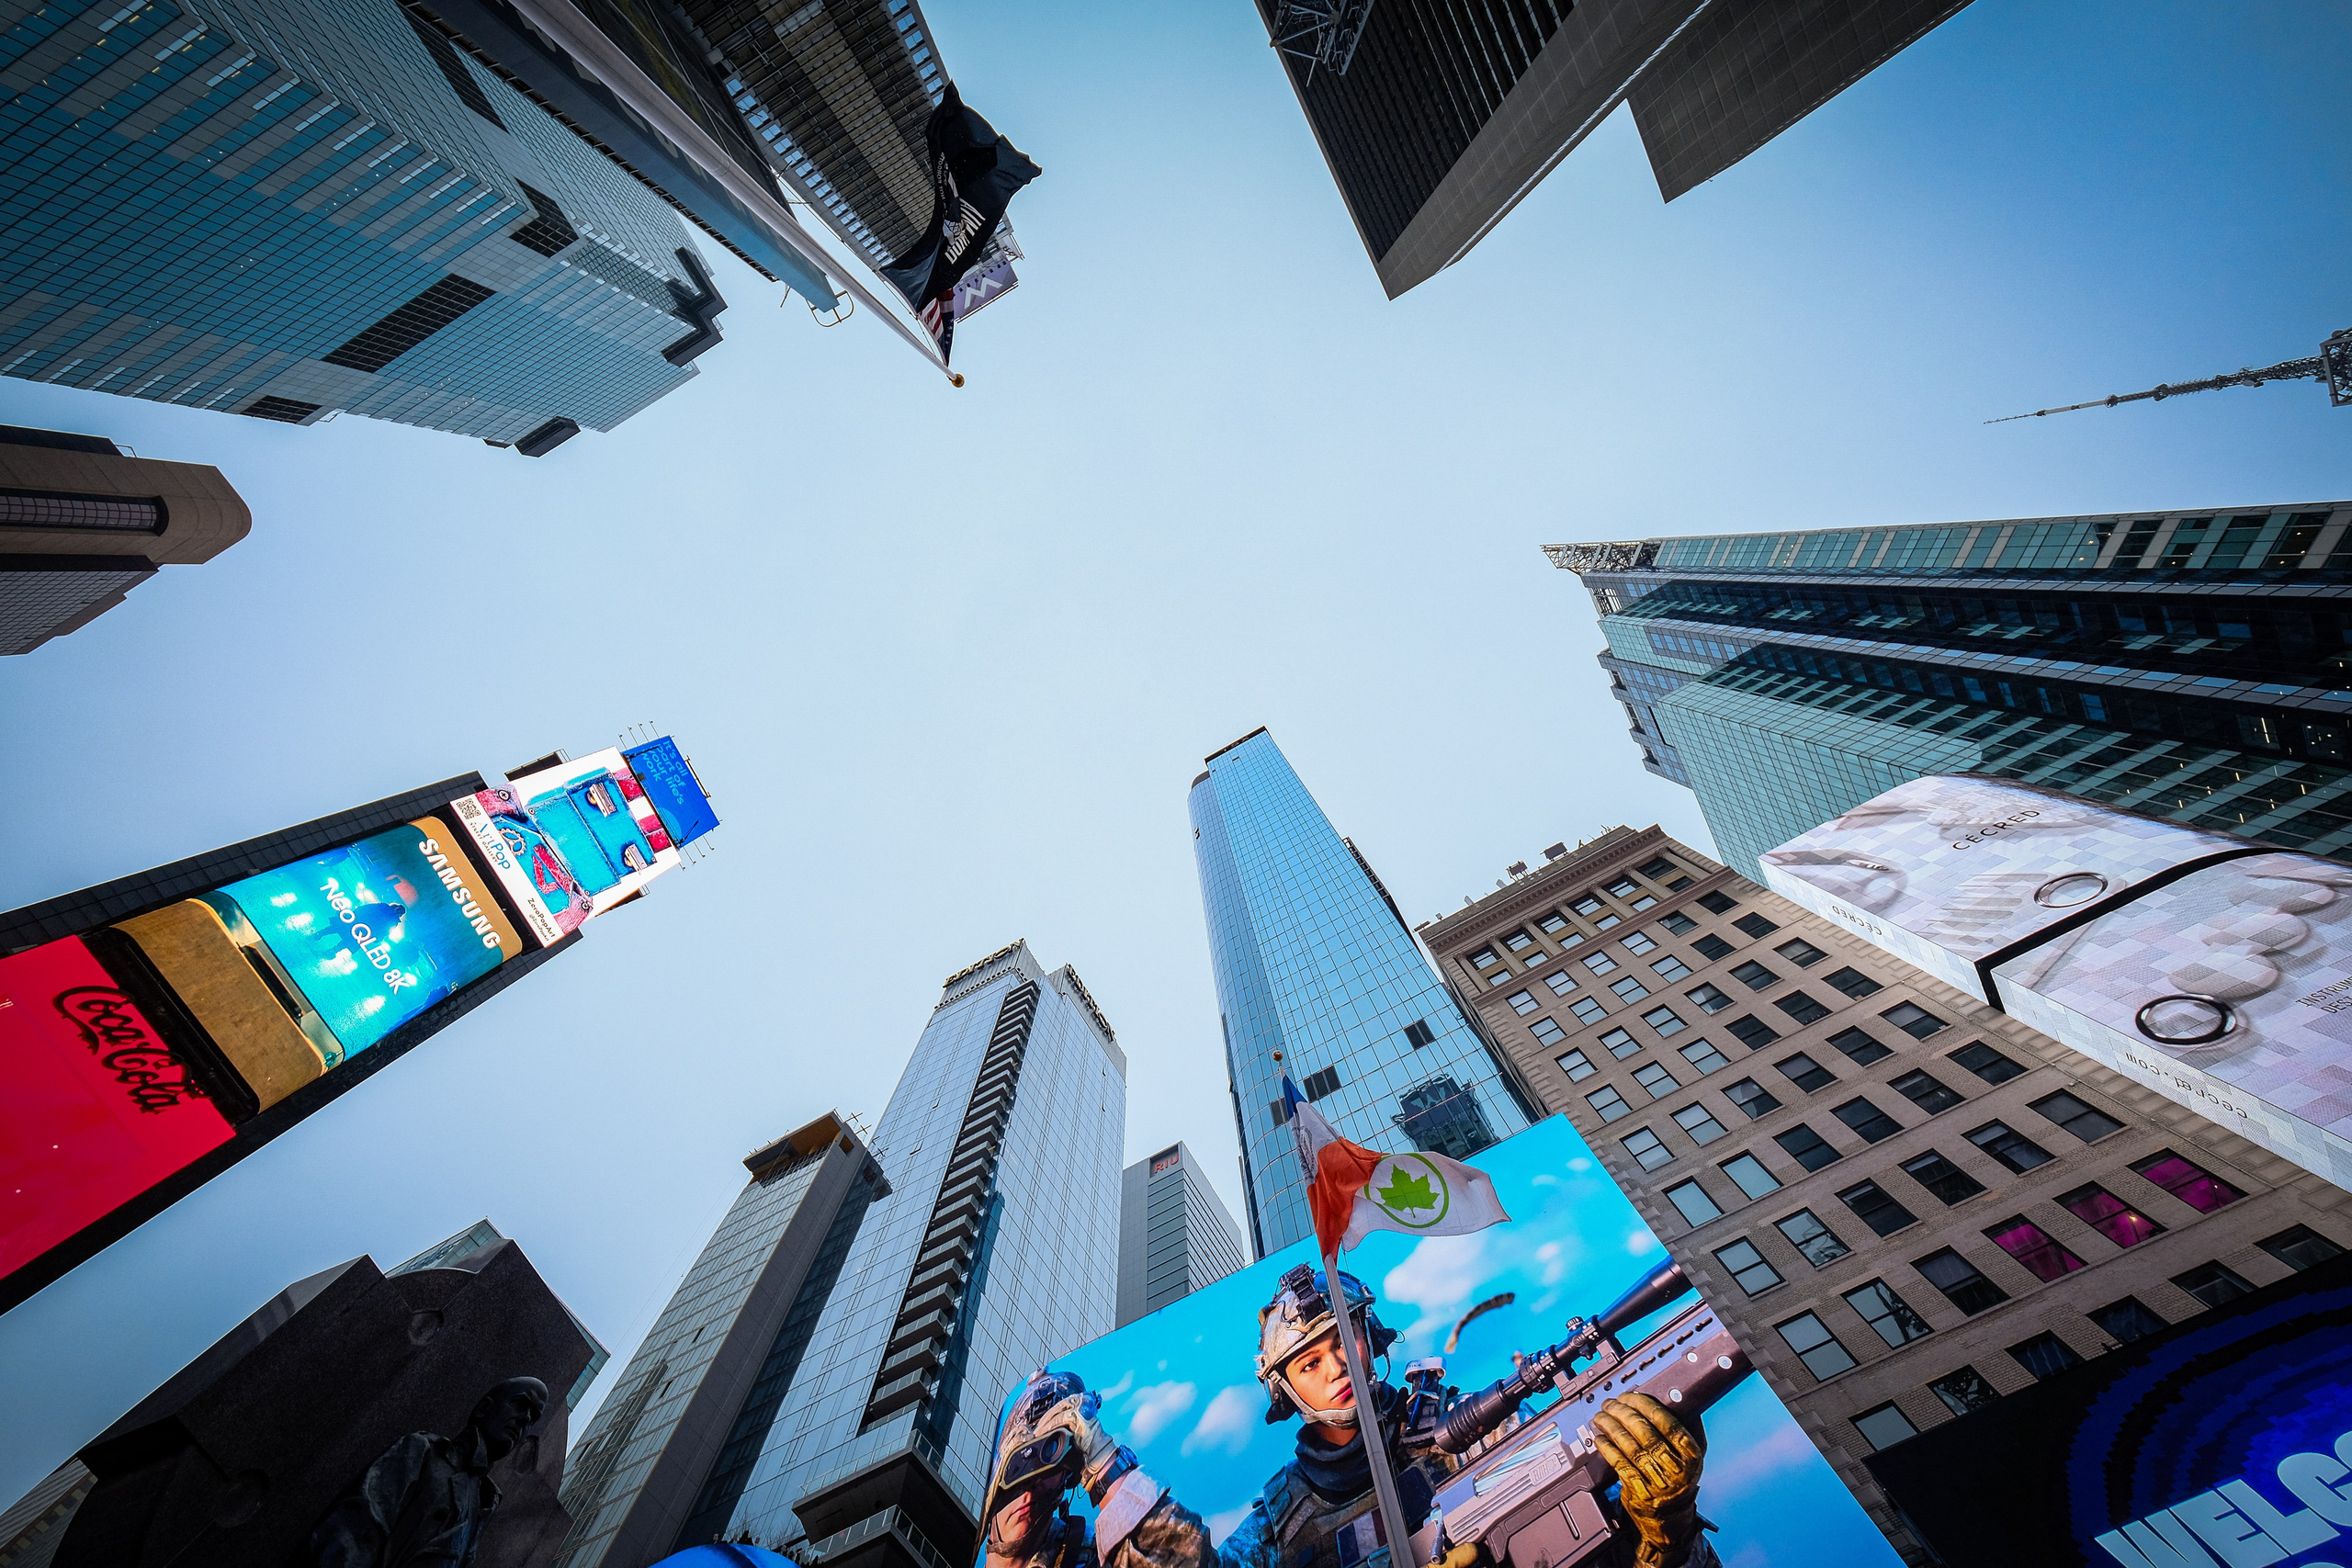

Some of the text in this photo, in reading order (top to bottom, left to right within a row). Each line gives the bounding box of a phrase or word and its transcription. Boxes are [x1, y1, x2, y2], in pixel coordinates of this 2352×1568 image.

[641, 752, 662, 782] work
[642, 749, 684, 805] your life's
[651, 744, 686, 787] part of
[662, 740, 688, 776] It's all
[469, 822, 499, 863] STREET GALLERY
[1952, 810, 2040, 851] CÉCRED
[418, 837, 502, 950] SAMSUNG
[320, 879, 410, 995] Neo QLED 8K
[527, 897, 556, 938] ZeroPopArt
[1832, 905, 1883, 935] CÉCRED
[942, 937, 1024, 988] EDITION
[1066, 963, 1115, 1042] EDITION
[52, 986, 200, 1115] Coca-Cola
[2125, 1052, 2247, 1119] cecred.com
[1154, 1154, 1179, 1174] RIU
[2094, 1430, 2352, 1568] WELC
